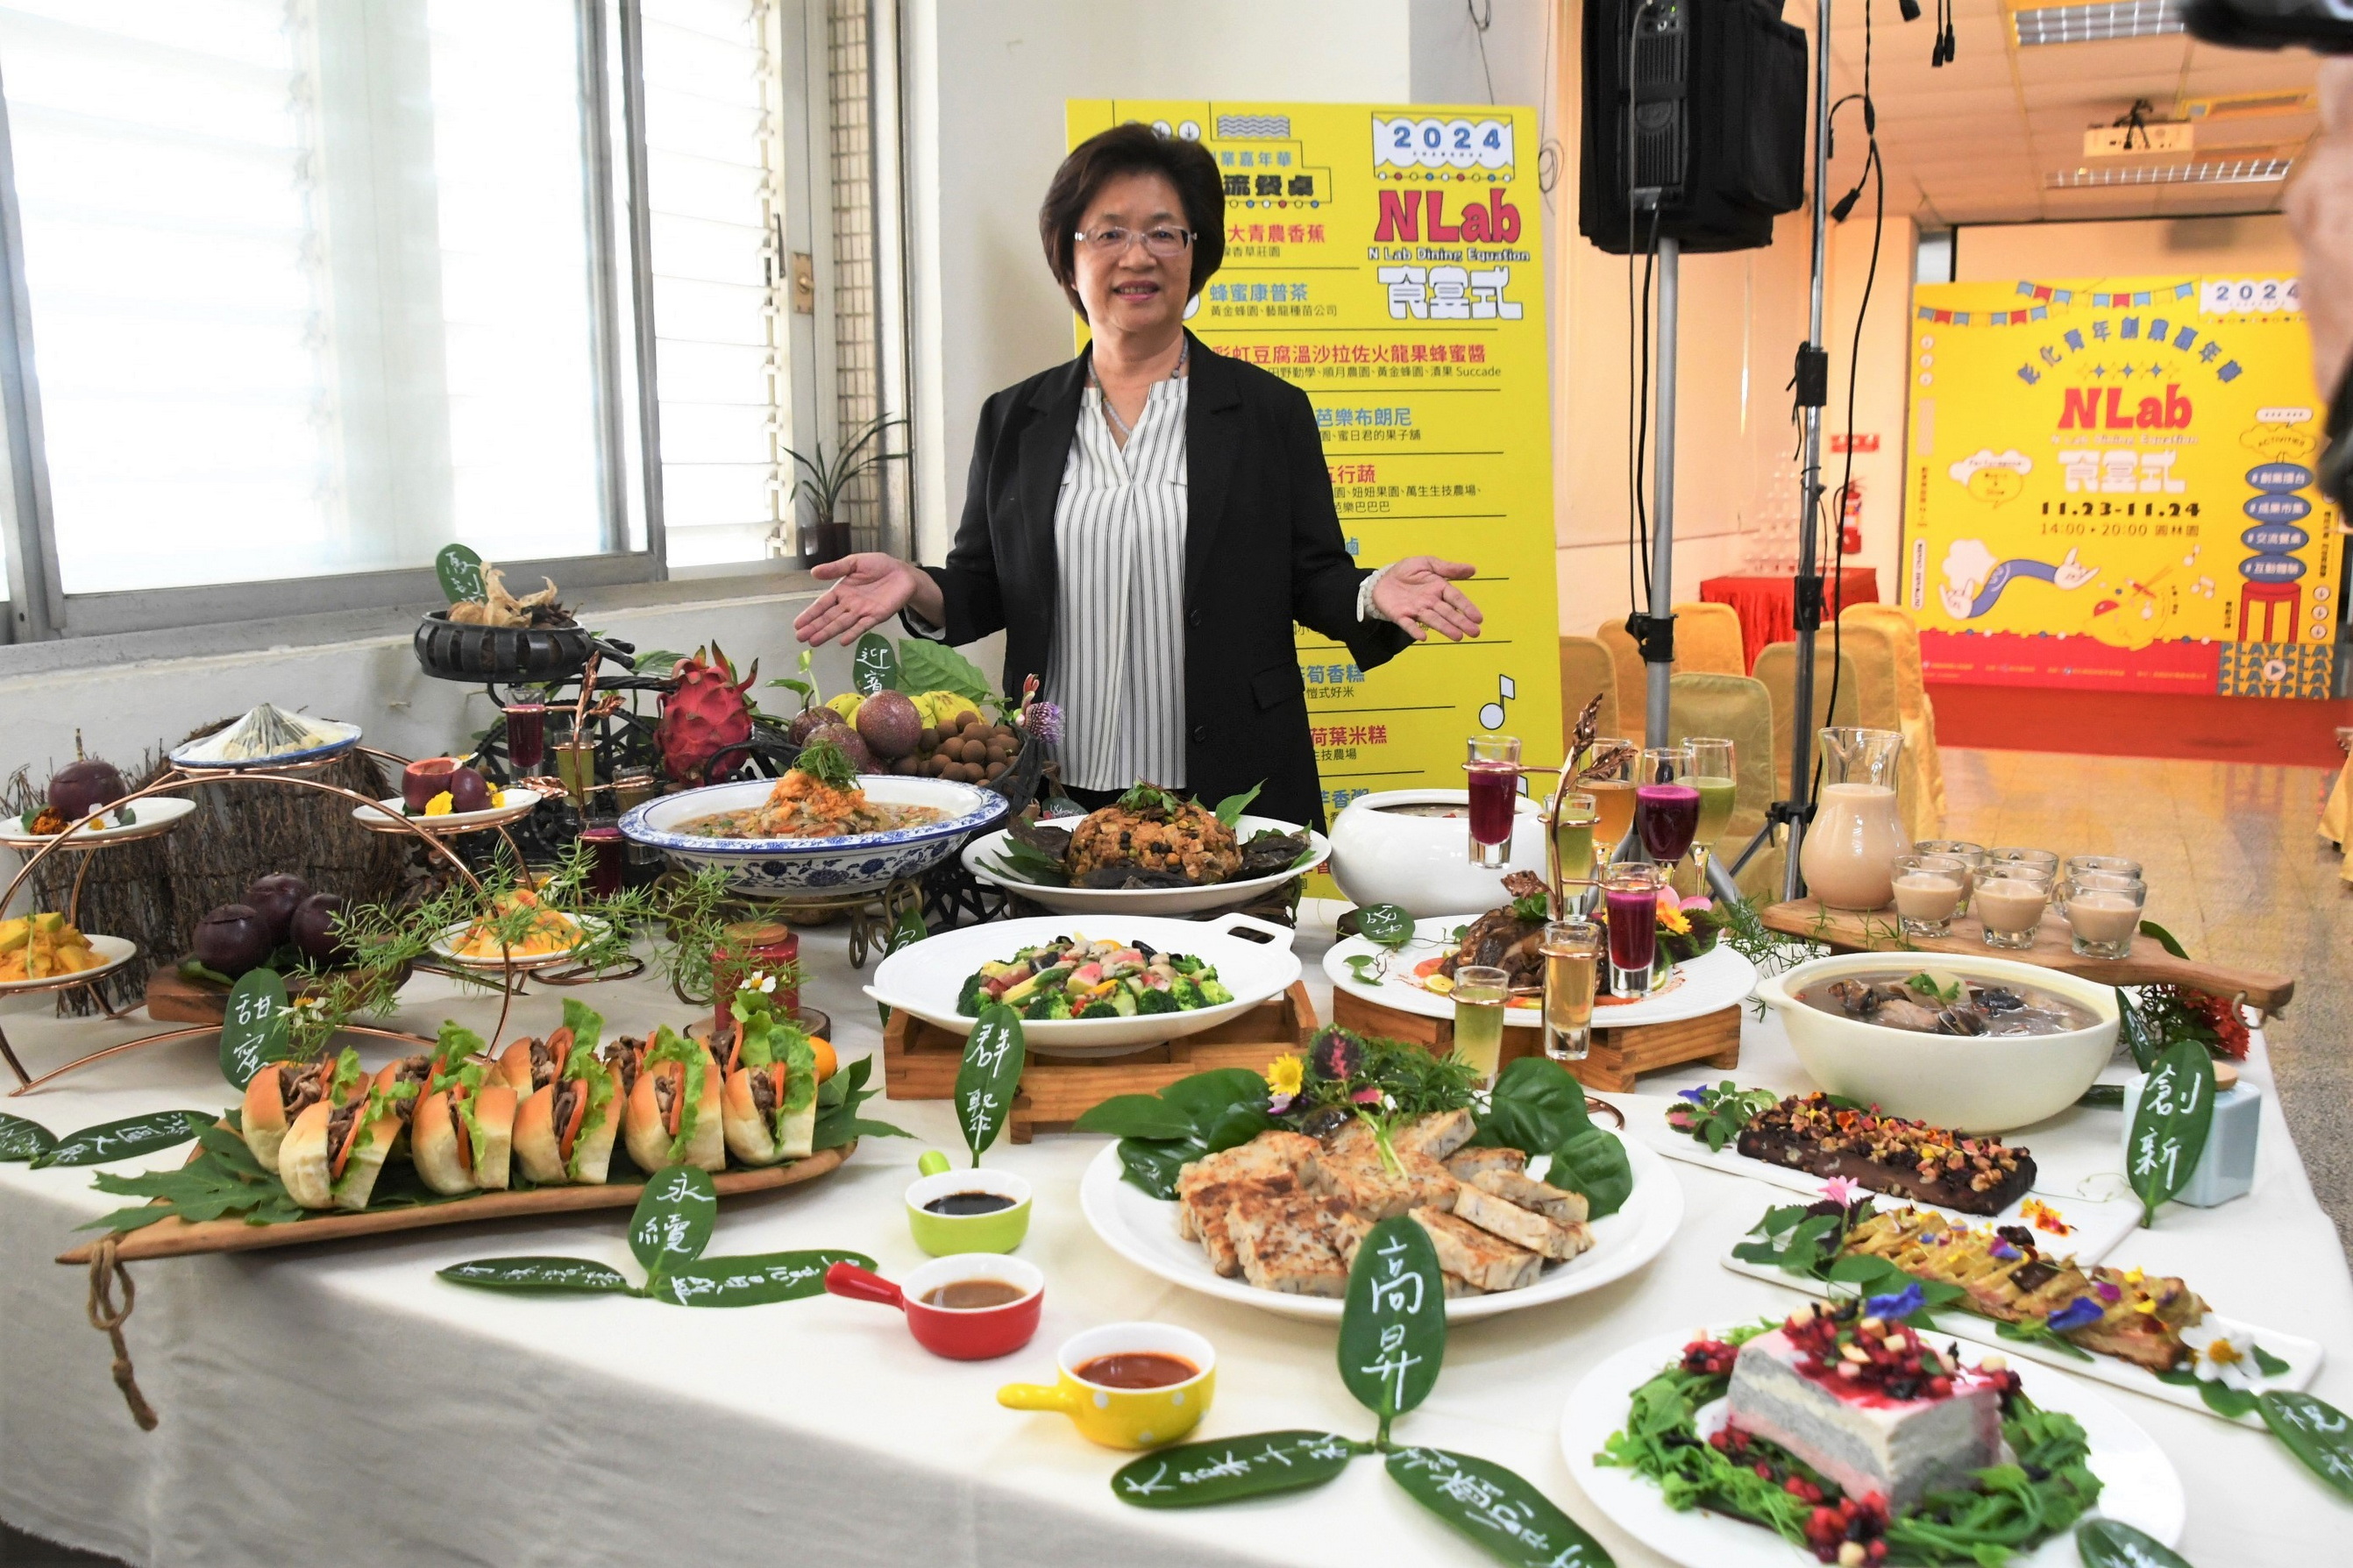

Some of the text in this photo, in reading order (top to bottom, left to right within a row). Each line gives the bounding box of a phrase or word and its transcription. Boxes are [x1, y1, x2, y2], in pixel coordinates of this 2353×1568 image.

[1394, 126, 1501, 150] 2024
[1212, 151, 1291, 167] 業嘉年華
[1374, 188, 1521, 244] NLab
[1227, 224, 1326, 243] 大青農香蕉
[1368, 247, 1531, 263] N Lab Dining Equation
[1210, 283, 1309, 302] 蜂蜜康普茶
[1456, 366, 1502, 378] Succade
[1315, 408, 1412, 428] 芭樂布朗尼
[2058, 384, 2192, 429] NLab
[2042, 501, 2200, 516] 11.23-11.24
[1311, 724, 1388, 747] 荷葉米糕
[965, 1022, 1011, 1151] 群聚
[2133, 1062, 2202, 1191] 創新
[638, 1171, 717, 1253] 永續
[1361, 1235, 1425, 1411] 高昇
